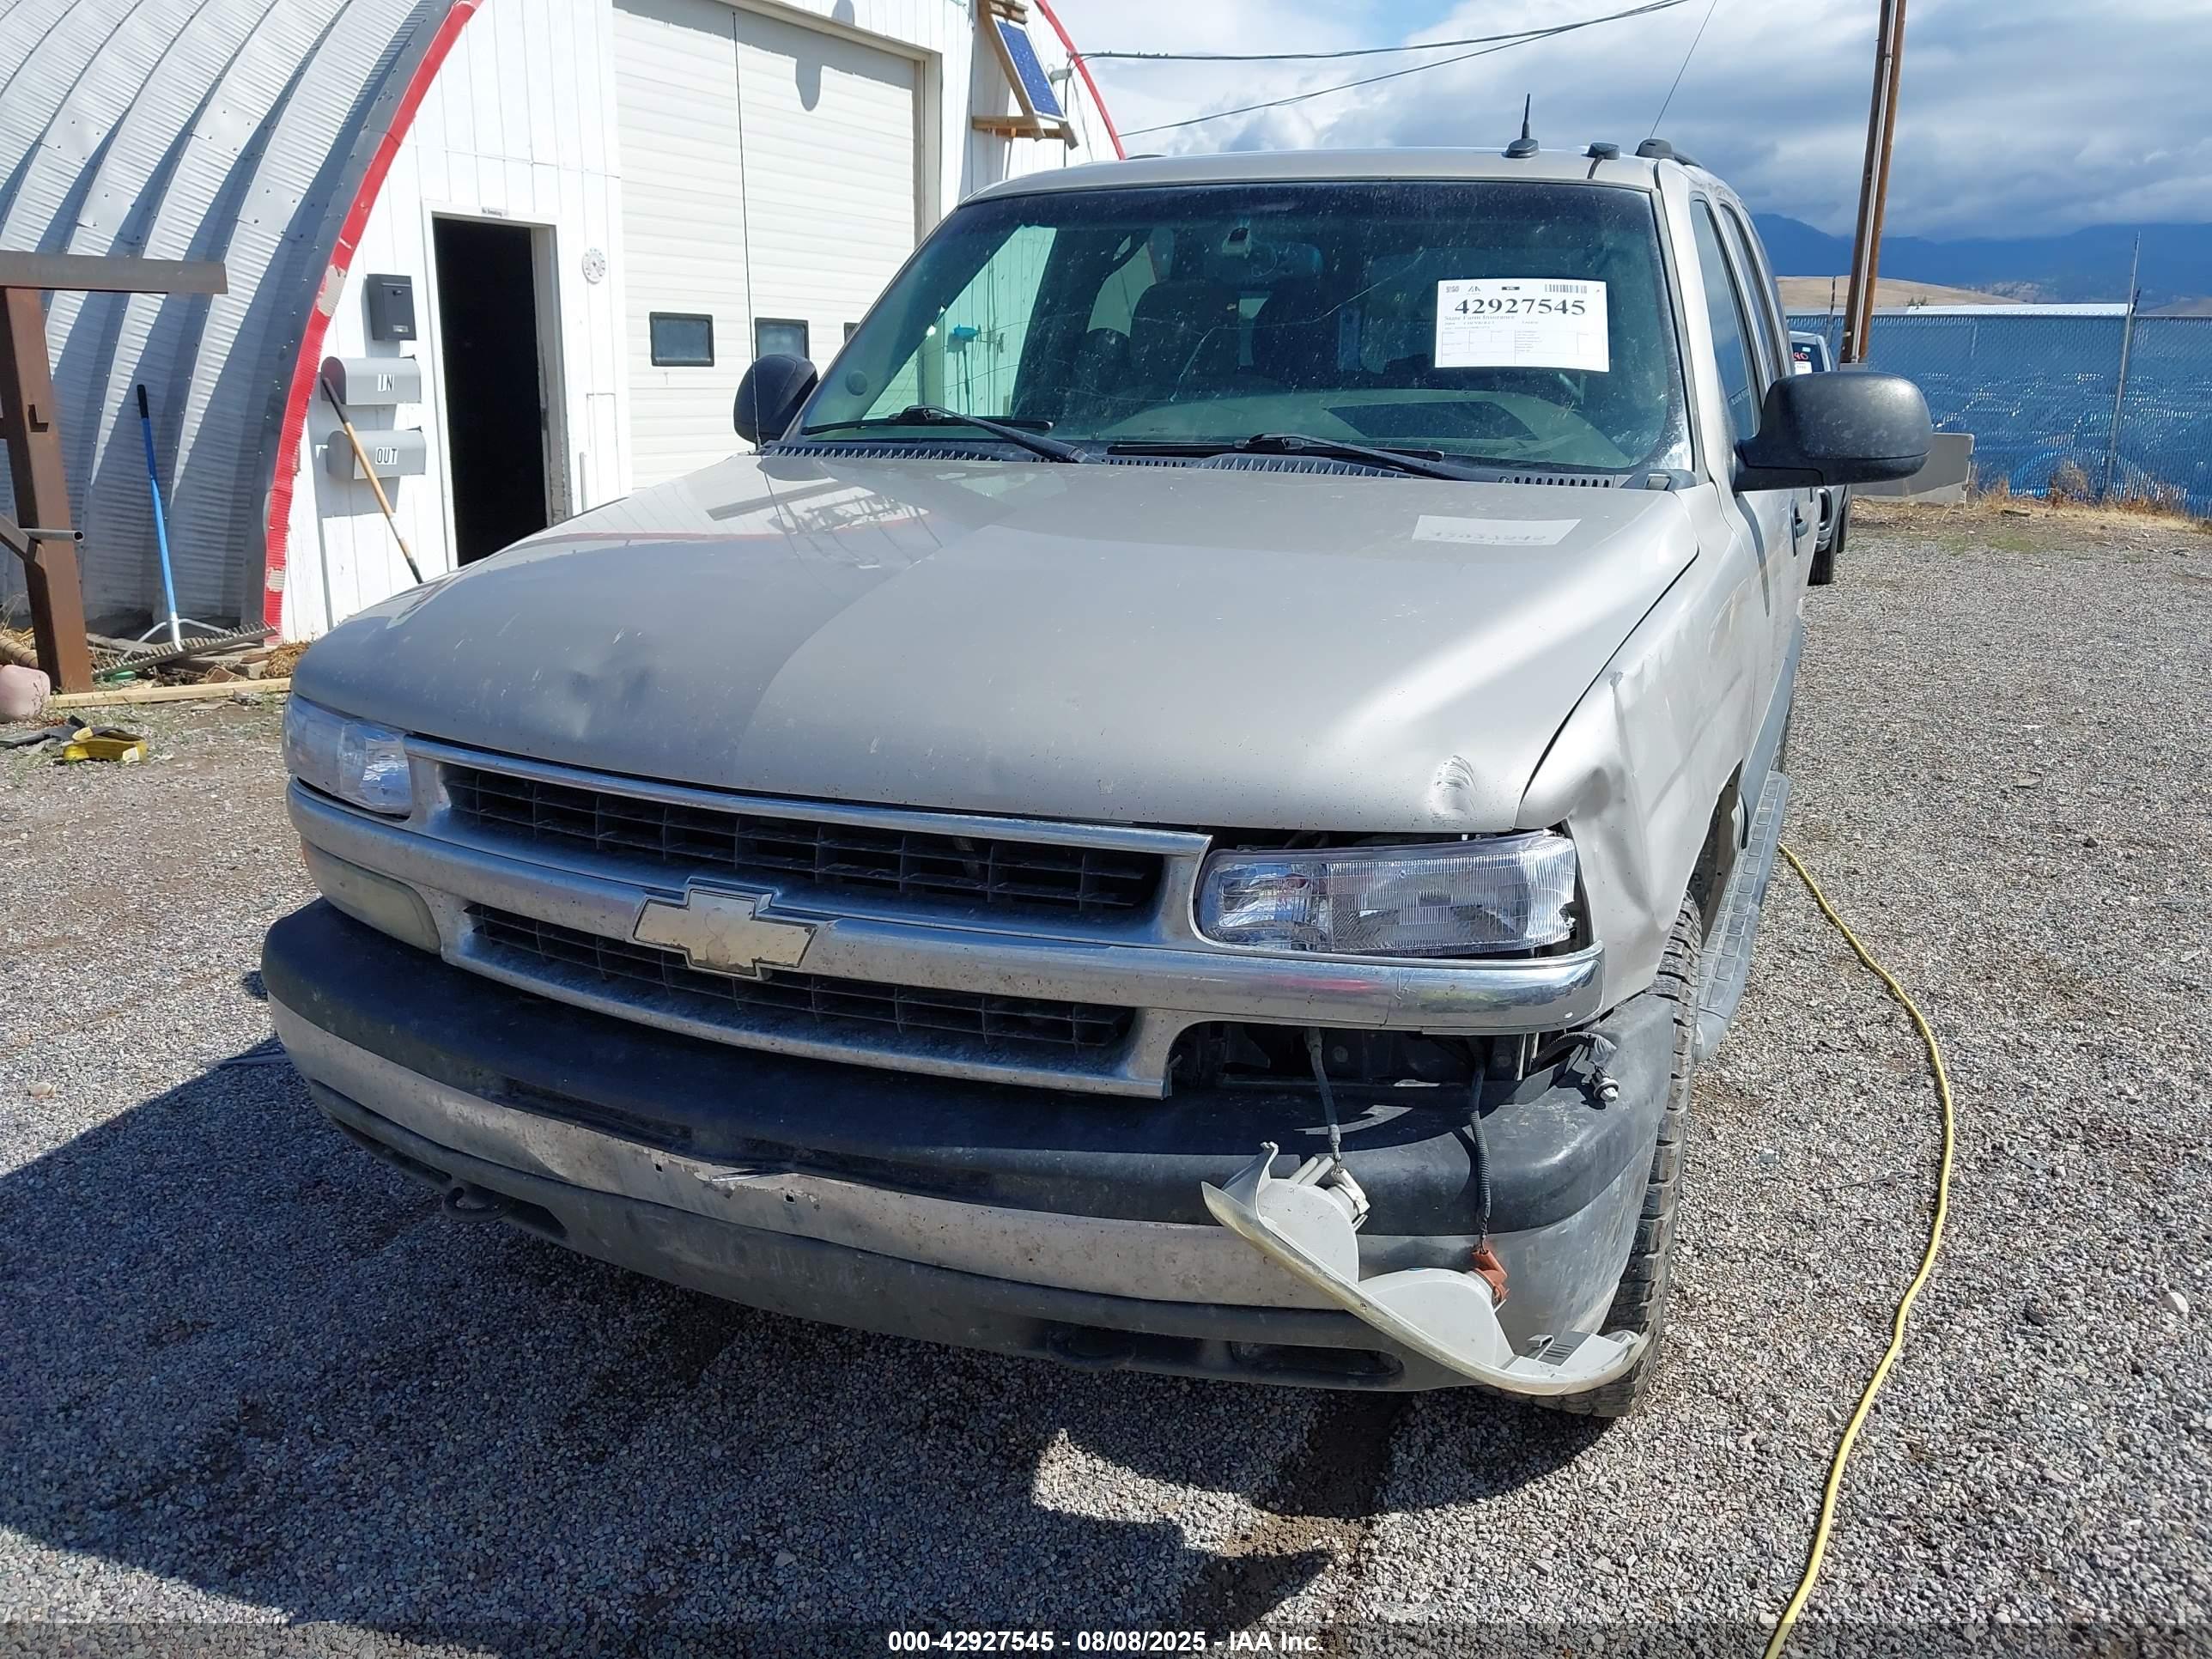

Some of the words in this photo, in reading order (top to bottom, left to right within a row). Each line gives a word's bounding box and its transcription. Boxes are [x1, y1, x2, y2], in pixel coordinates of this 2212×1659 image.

[1455, 298, 1586, 315] 42927545
[380, 374, 393, 391] IN
[376, 448, 398, 464] OUT
